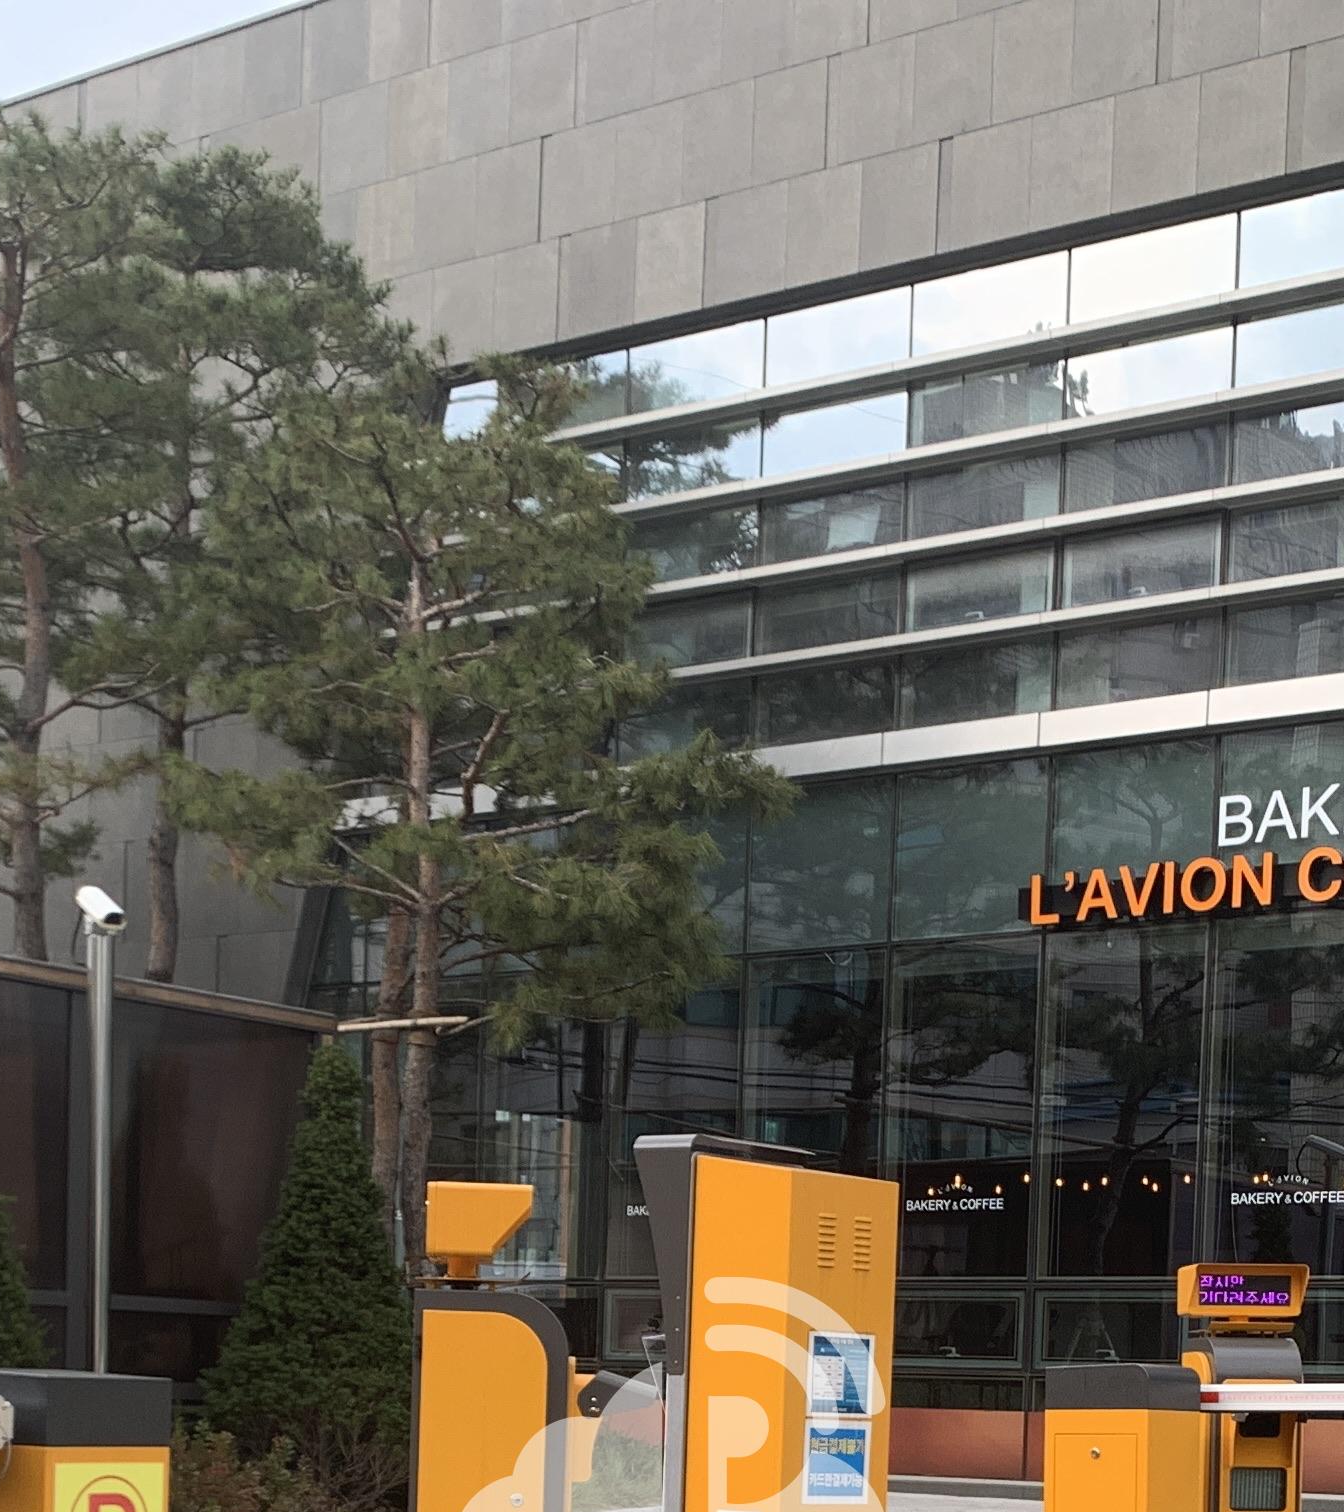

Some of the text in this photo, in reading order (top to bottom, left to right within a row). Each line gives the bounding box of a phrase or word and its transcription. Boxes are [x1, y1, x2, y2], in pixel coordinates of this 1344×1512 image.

[906, 1200, 951, 1211] BAKERY
[959, 1198, 1004, 1210] COFFEE
[1231, 1192, 1284, 1205] BAKERY
[1199, 1291, 1289, 1304] 기다려주세요
